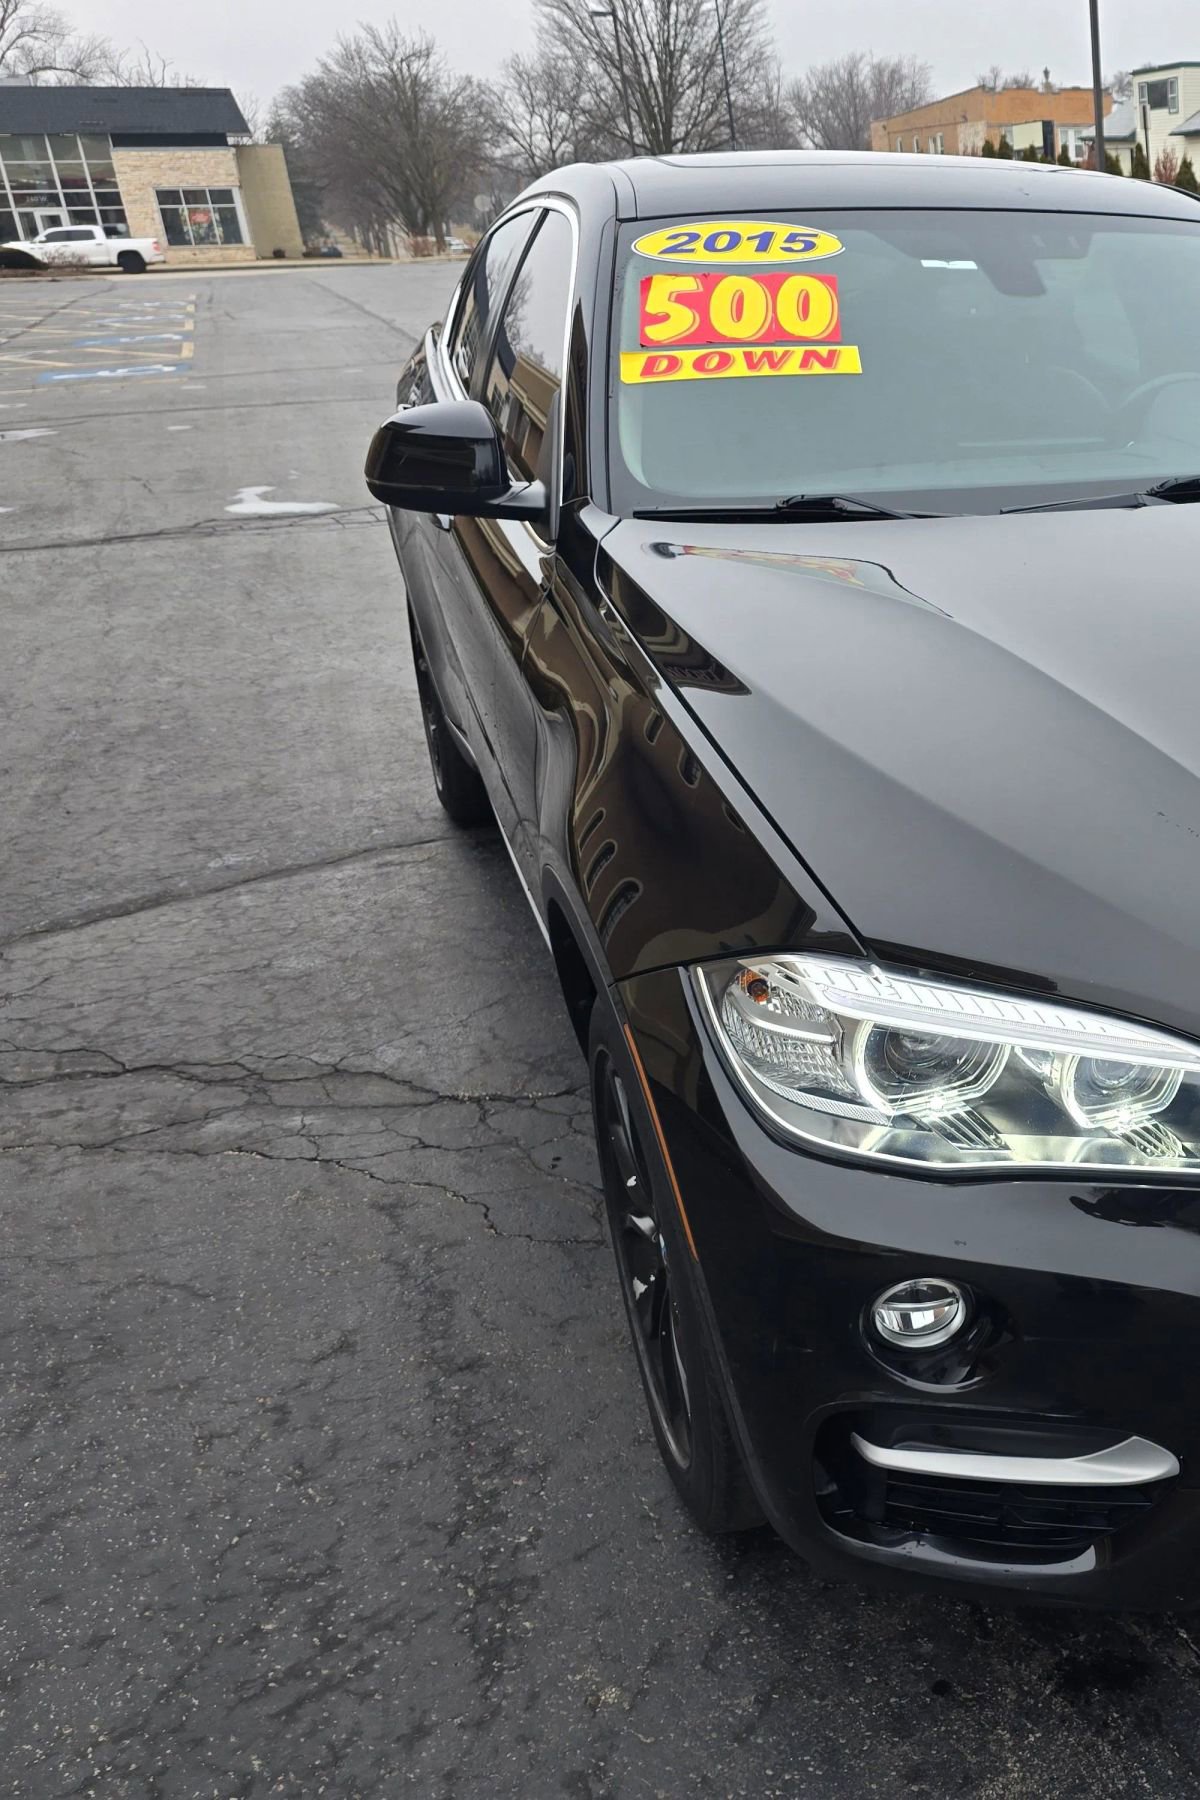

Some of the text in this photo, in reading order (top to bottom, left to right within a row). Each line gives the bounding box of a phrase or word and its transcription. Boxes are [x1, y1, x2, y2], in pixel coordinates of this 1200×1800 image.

[657, 231, 819, 254] 2015
[644, 274, 838, 343] 500
[639, 349, 840, 377] DOWN
